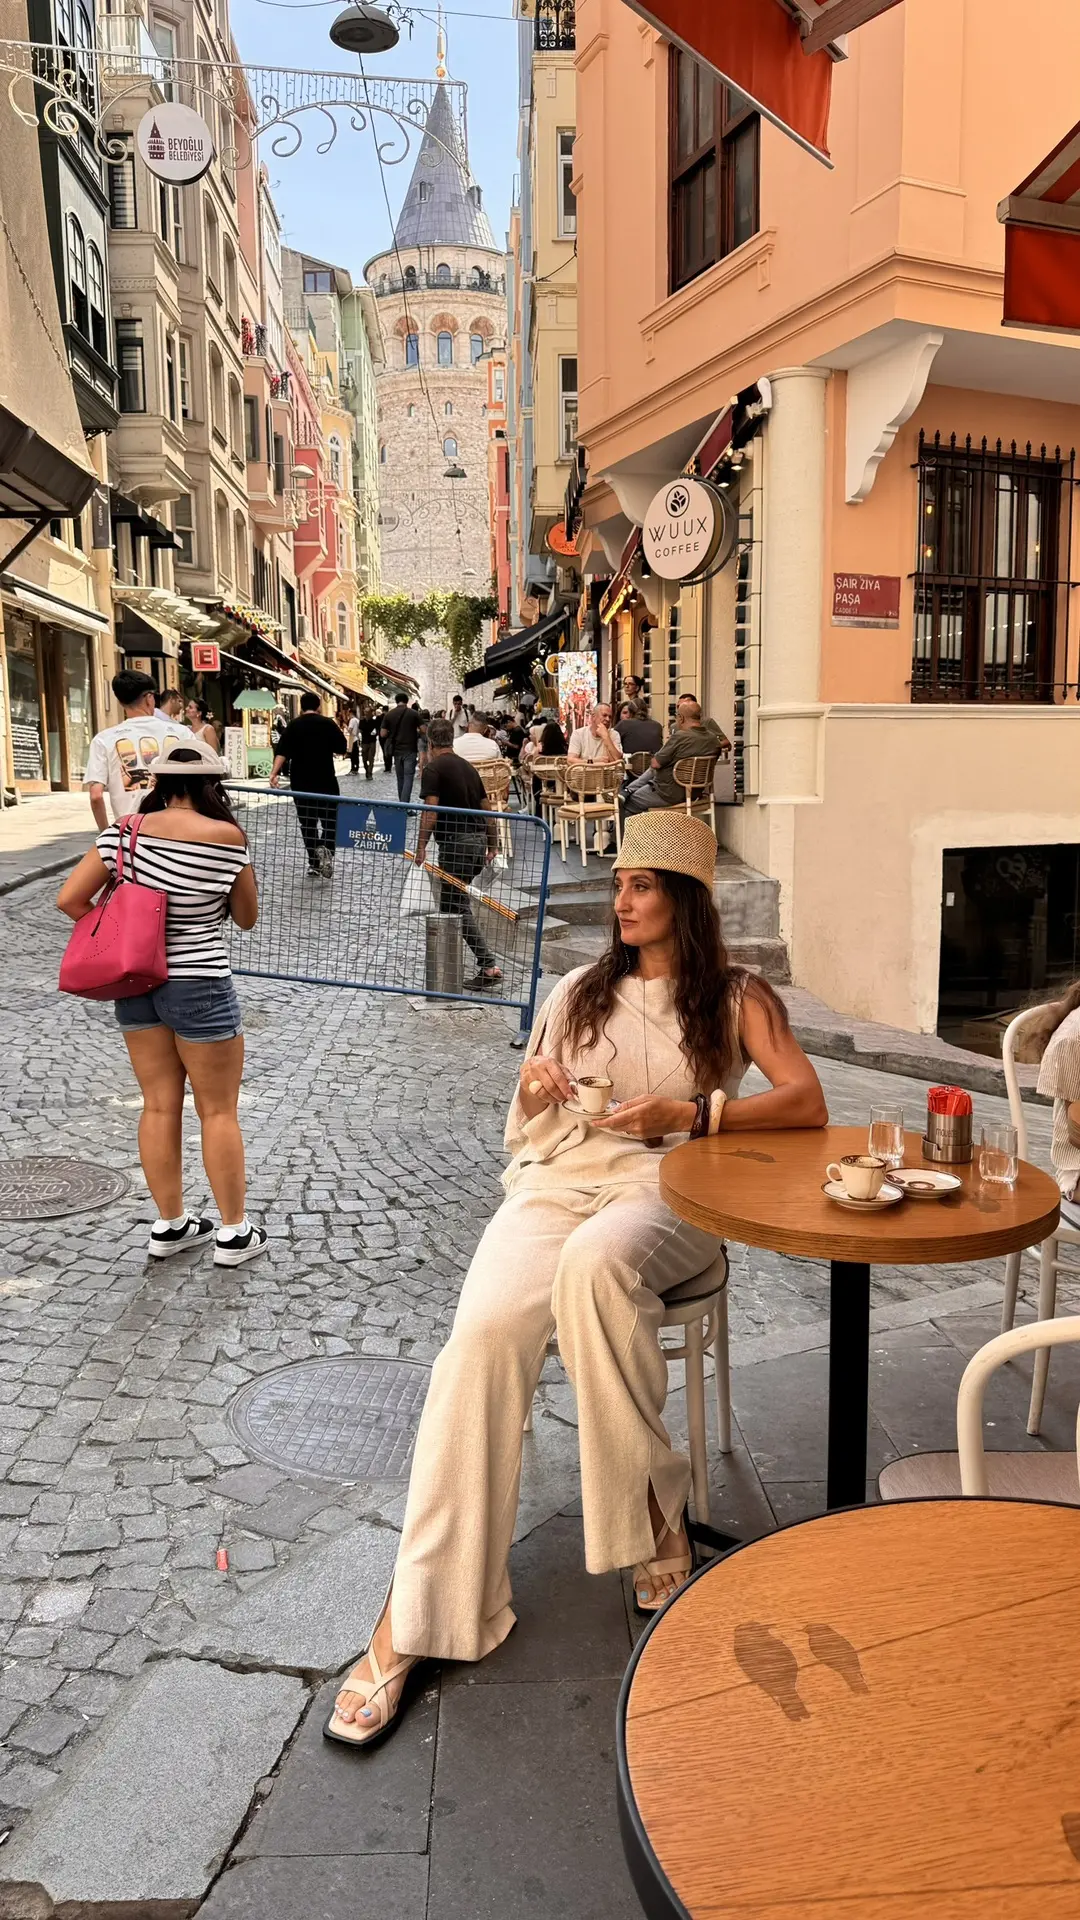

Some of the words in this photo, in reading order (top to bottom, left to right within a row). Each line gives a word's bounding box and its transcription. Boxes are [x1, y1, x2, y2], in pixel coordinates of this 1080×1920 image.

[168, 136, 204, 151] BEYOĞLU
[648, 516, 708, 543] WUUX
[655, 541, 700, 558] COFFEE
[835, 592, 861, 606] PAŞA
[199, 648, 213, 665] E
[348, 829, 393, 843] BEYOĞLU
[353, 839, 389, 852] ZABITA
